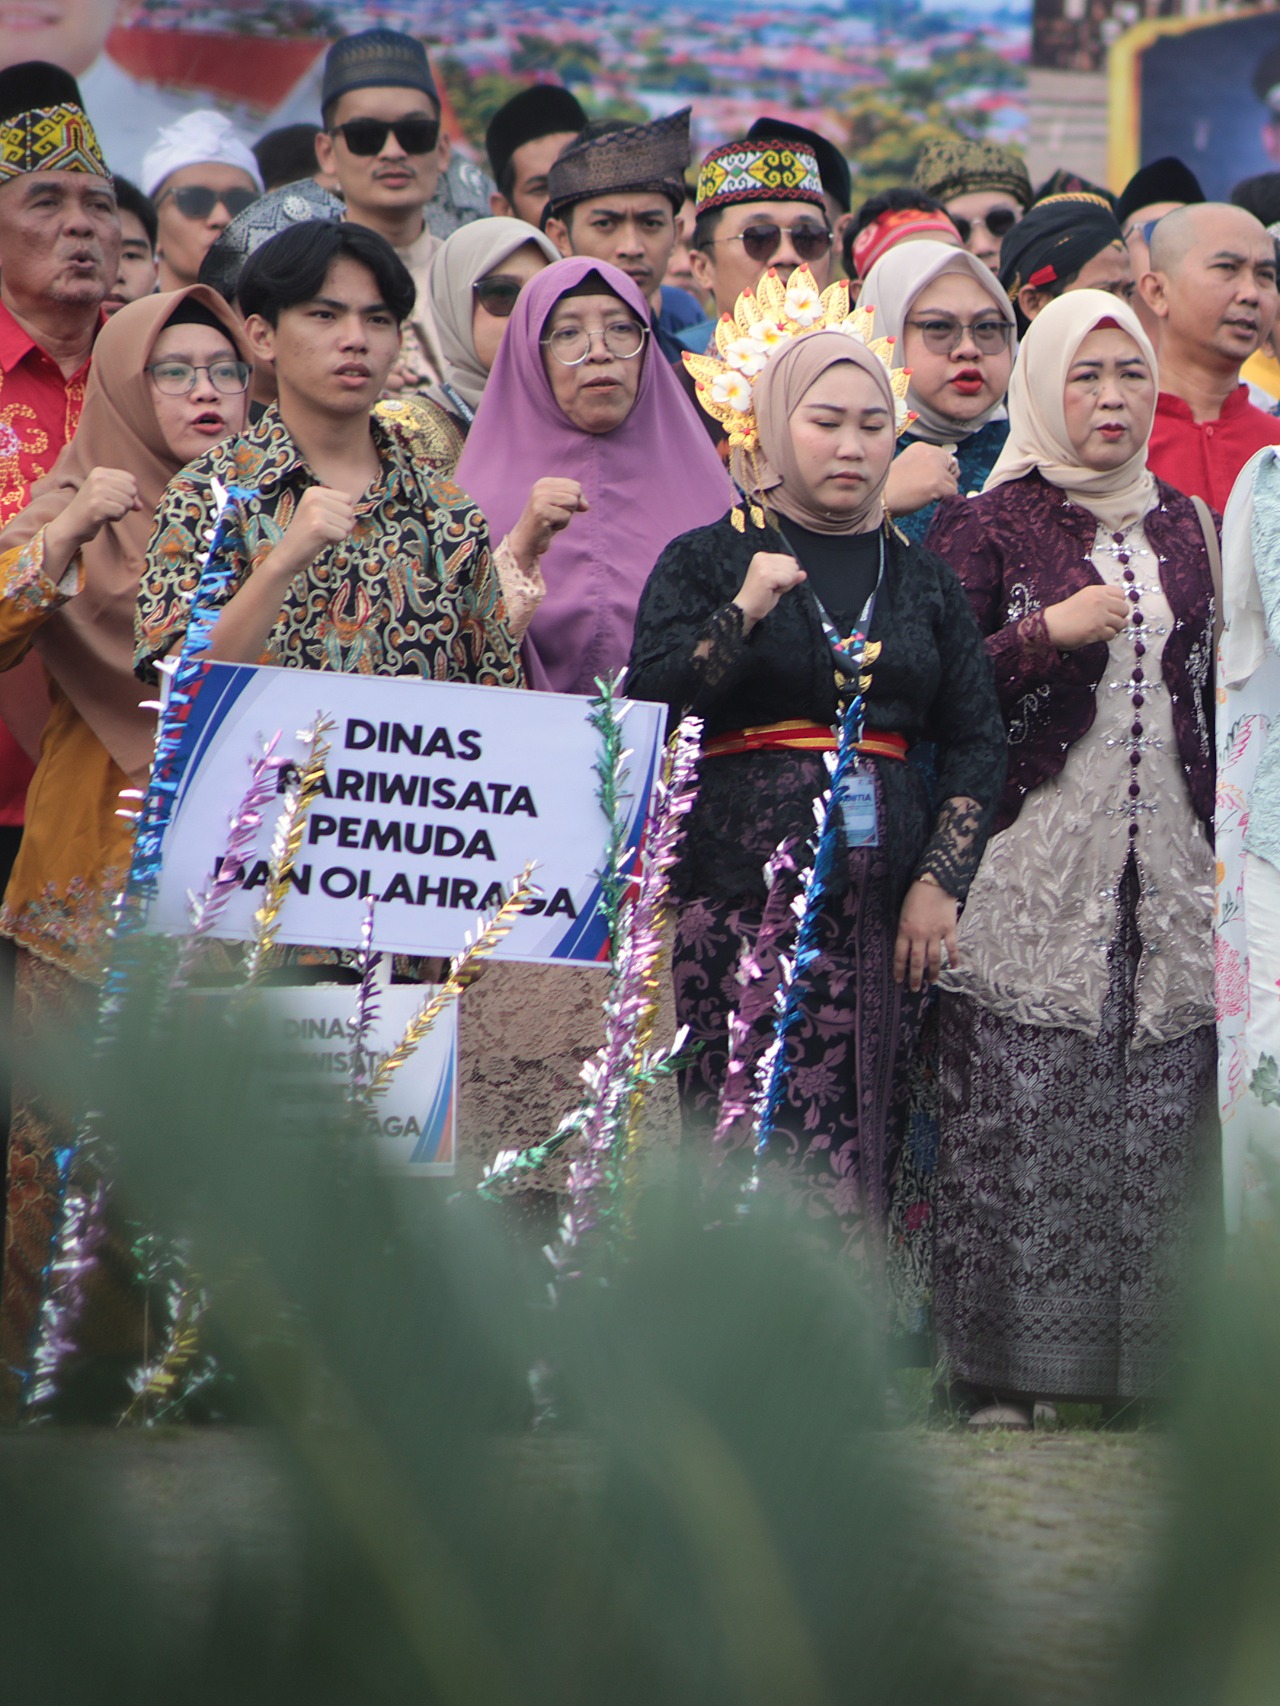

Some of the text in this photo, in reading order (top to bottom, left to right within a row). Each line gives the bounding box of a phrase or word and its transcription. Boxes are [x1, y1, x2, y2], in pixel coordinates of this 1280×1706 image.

[345, 718, 482, 761] DINAS
[308, 813, 496, 861] PEMUDA
[283, 1017, 362, 1040] DINAS
